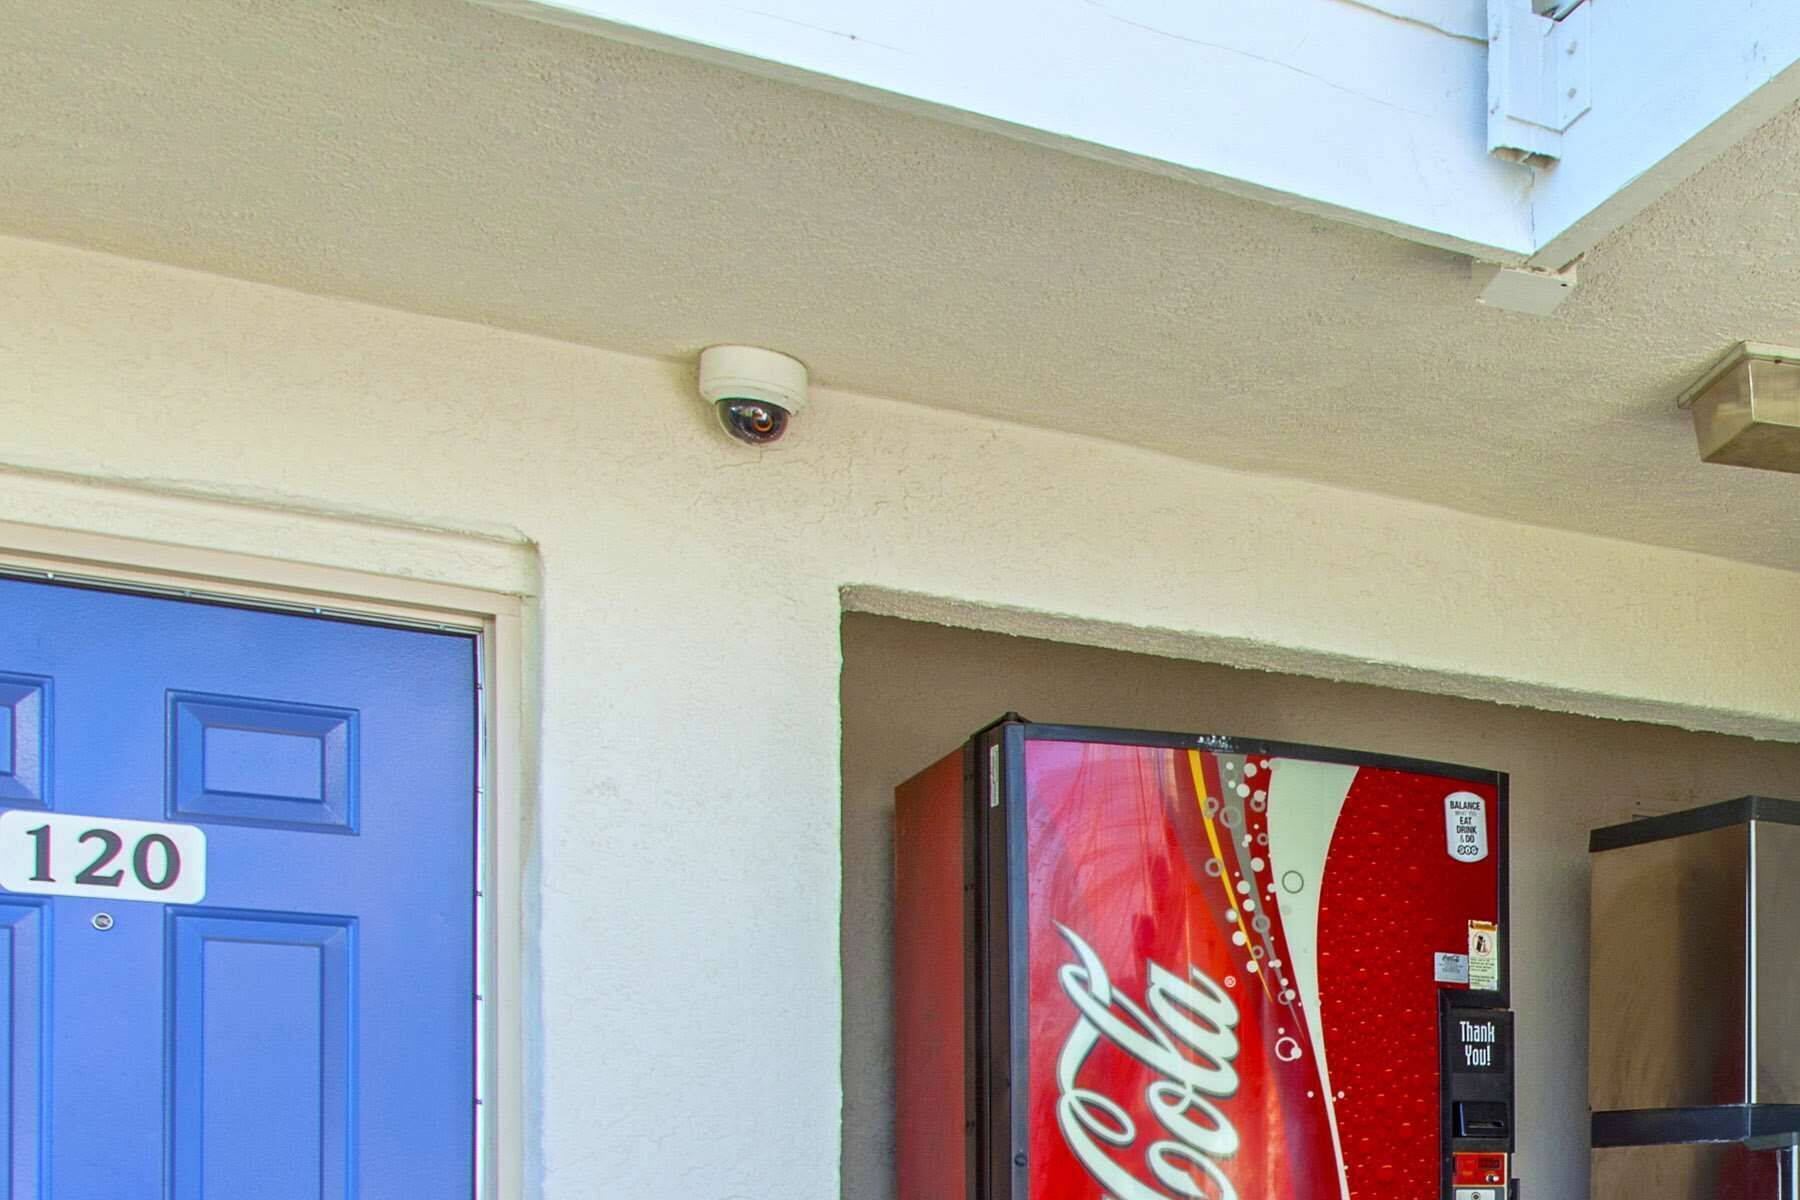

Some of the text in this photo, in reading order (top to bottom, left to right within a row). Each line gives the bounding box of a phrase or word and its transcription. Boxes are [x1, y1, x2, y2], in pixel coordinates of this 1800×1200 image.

[1450, 800, 1480, 811] BALANCE
[1459, 816, 1472, 825] EAT
[1456, 825, 1477, 834] DRINK
[1465, 835, 1475, 843] DO
[26, 824, 181, 891] 120
[1459, 1020, 1495, 1043] Thank
[1465, 1045, 1491, 1066] You!
